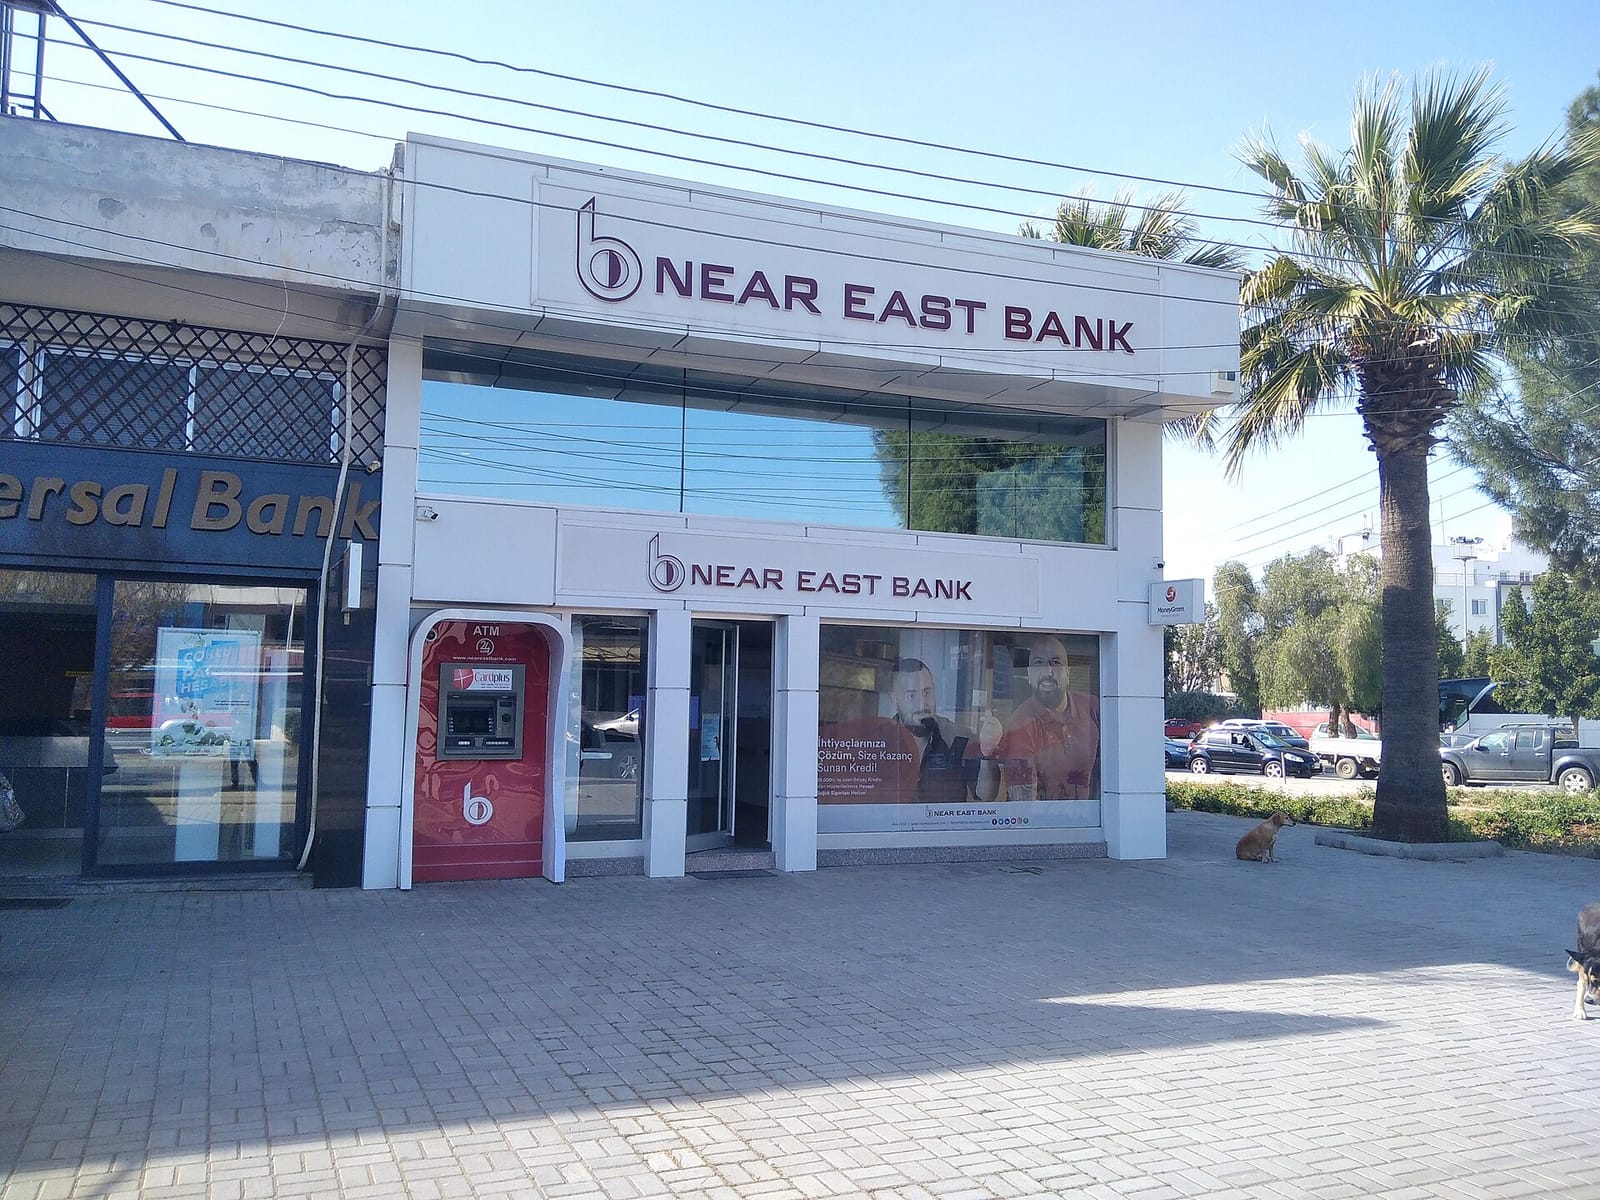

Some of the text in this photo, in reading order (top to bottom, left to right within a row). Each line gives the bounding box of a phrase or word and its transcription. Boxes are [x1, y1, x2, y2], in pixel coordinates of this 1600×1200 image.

[656, 256, 822, 315] NEAR
[843, 283, 987, 335] EAST
[1003, 305, 1136, 355] BANK
[0, 468, 381, 541] ersal Bank
[691, 564, 784, 591] NEAR
[797, 570, 882, 595] EAST
[891, 576, 973, 601] BANK
[473, 625, 500, 636] ATM
[475, 672, 510, 684] Cardplus
[818, 736, 886, 750] İhtiyaçlarınıza
[818, 750, 913, 763] Çözüm, Size Kazanç
[817, 763, 878, 773] Sunan Kredi!
